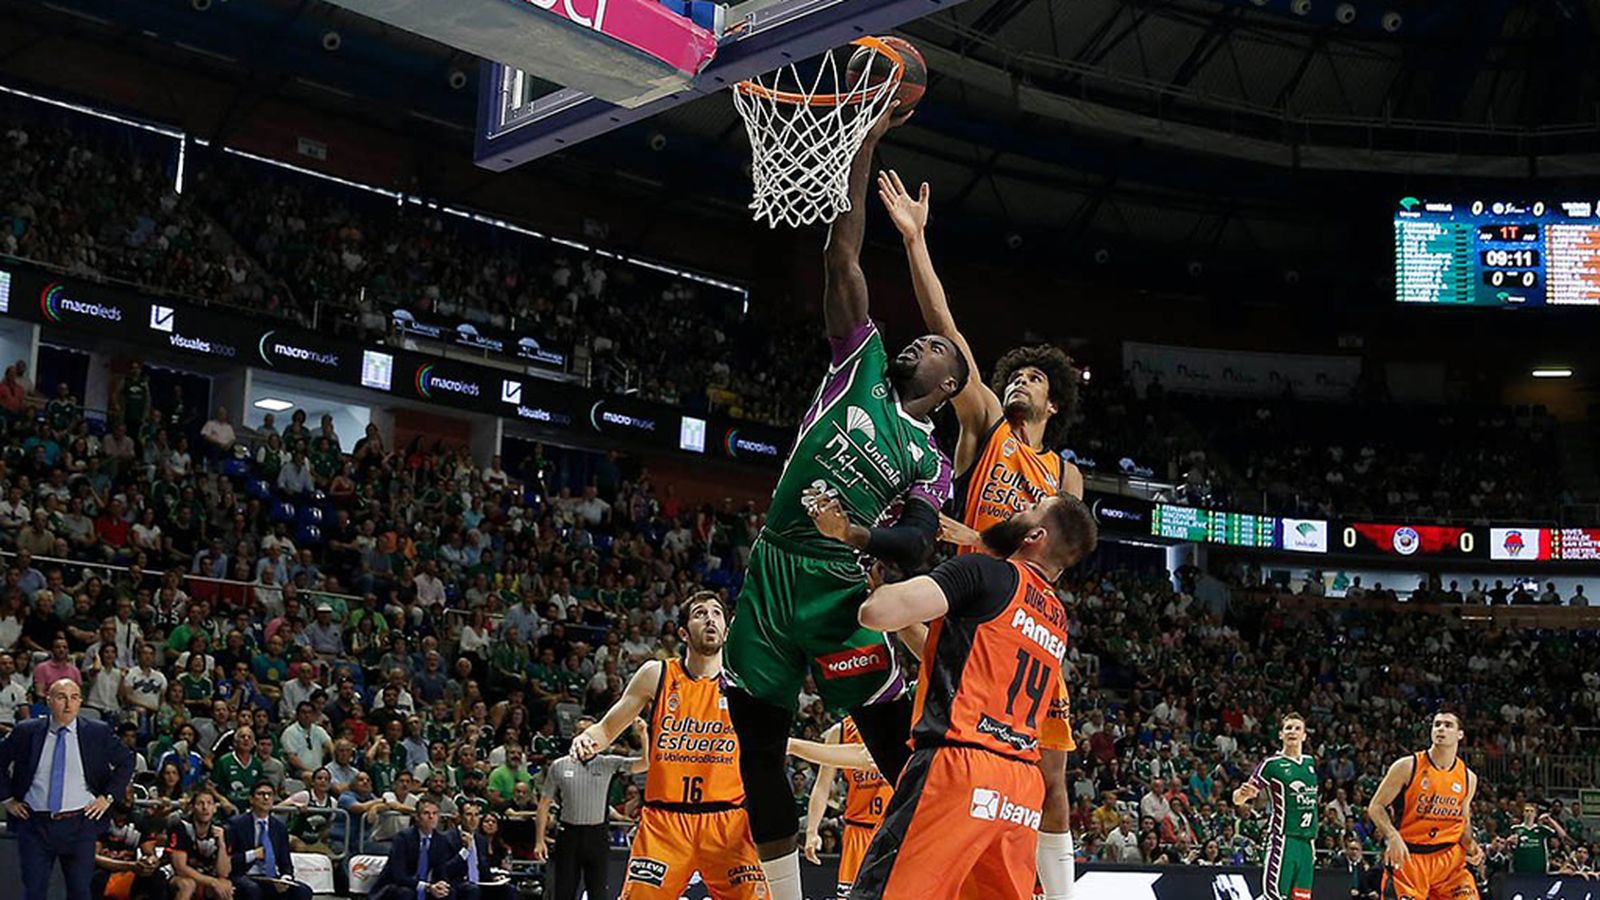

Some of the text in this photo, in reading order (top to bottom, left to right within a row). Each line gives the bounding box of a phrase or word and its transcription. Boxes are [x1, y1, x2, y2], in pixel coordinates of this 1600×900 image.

[1472, 201, 1483, 216] 0
[1533, 202, 1544, 216] 0
[1486, 250, 1532, 266] 09:11
[60, 298, 122, 322] macroleds
[273, 343, 341, 367] macromusic
[430, 376, 480, 397] macroleds
[602, 410, 656, 431] macromusic
[864, 440, 901, 486] Unicaja
[1343, 527, 1357, 548] 0
[1460, 532, 1474, 553] 0
[1005, 648, 1051, 729] 14
[661, 715, 724, 735] Cultura
[656, 732, 736, 753] Esfuerzo
[681, 775, 704, 802] 16
